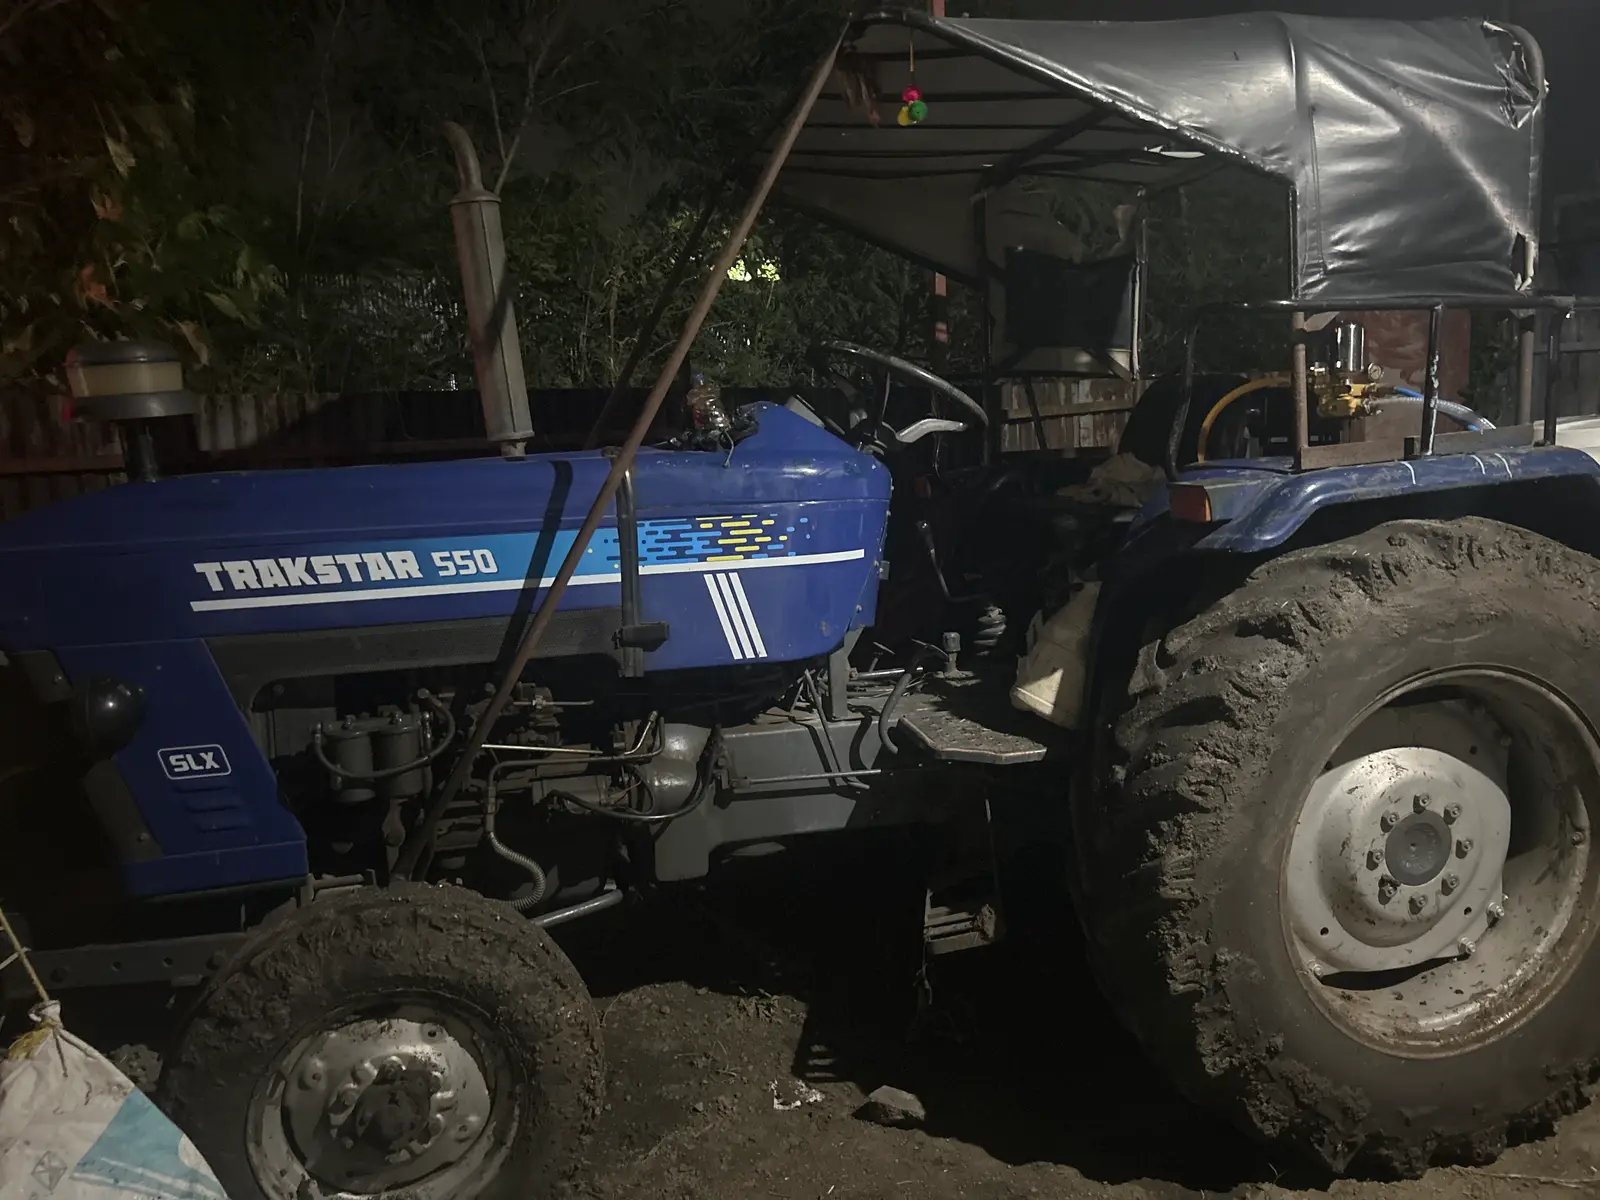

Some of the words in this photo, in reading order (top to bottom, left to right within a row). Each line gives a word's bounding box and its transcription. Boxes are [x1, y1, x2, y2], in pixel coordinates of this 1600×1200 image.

[193, 550, 423, 592] TRAKSTAR
[431, 549, 498, 577] 550
[169, 752, 220, 772] SLX
